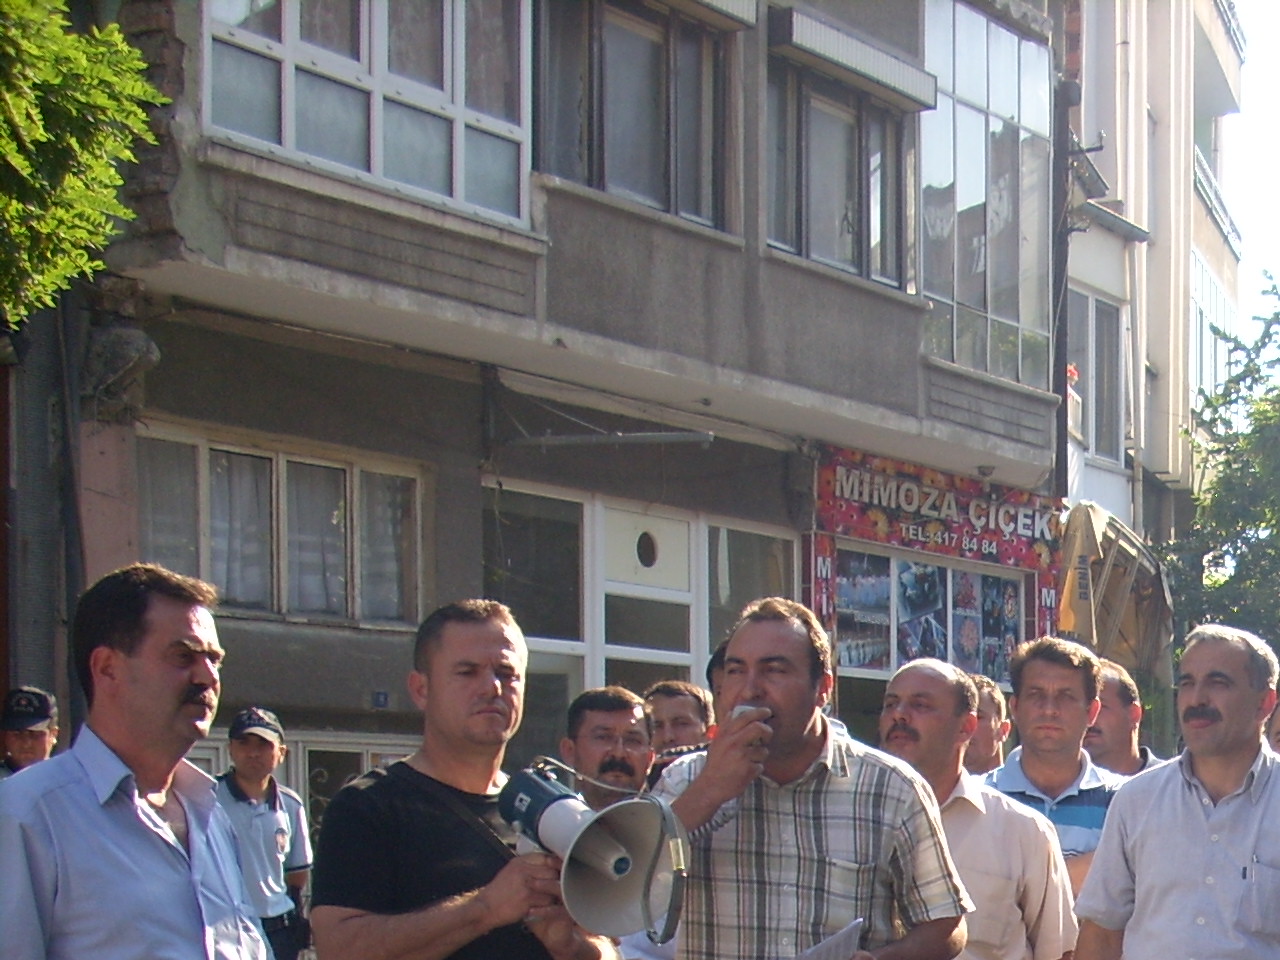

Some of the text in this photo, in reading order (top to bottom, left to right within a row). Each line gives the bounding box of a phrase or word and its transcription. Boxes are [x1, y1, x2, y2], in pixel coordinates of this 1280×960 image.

[835, 464, 1052, 540] MİMOZA ÇİÇEK
[900, 523, 997, 555] TEL: 417 84 84
